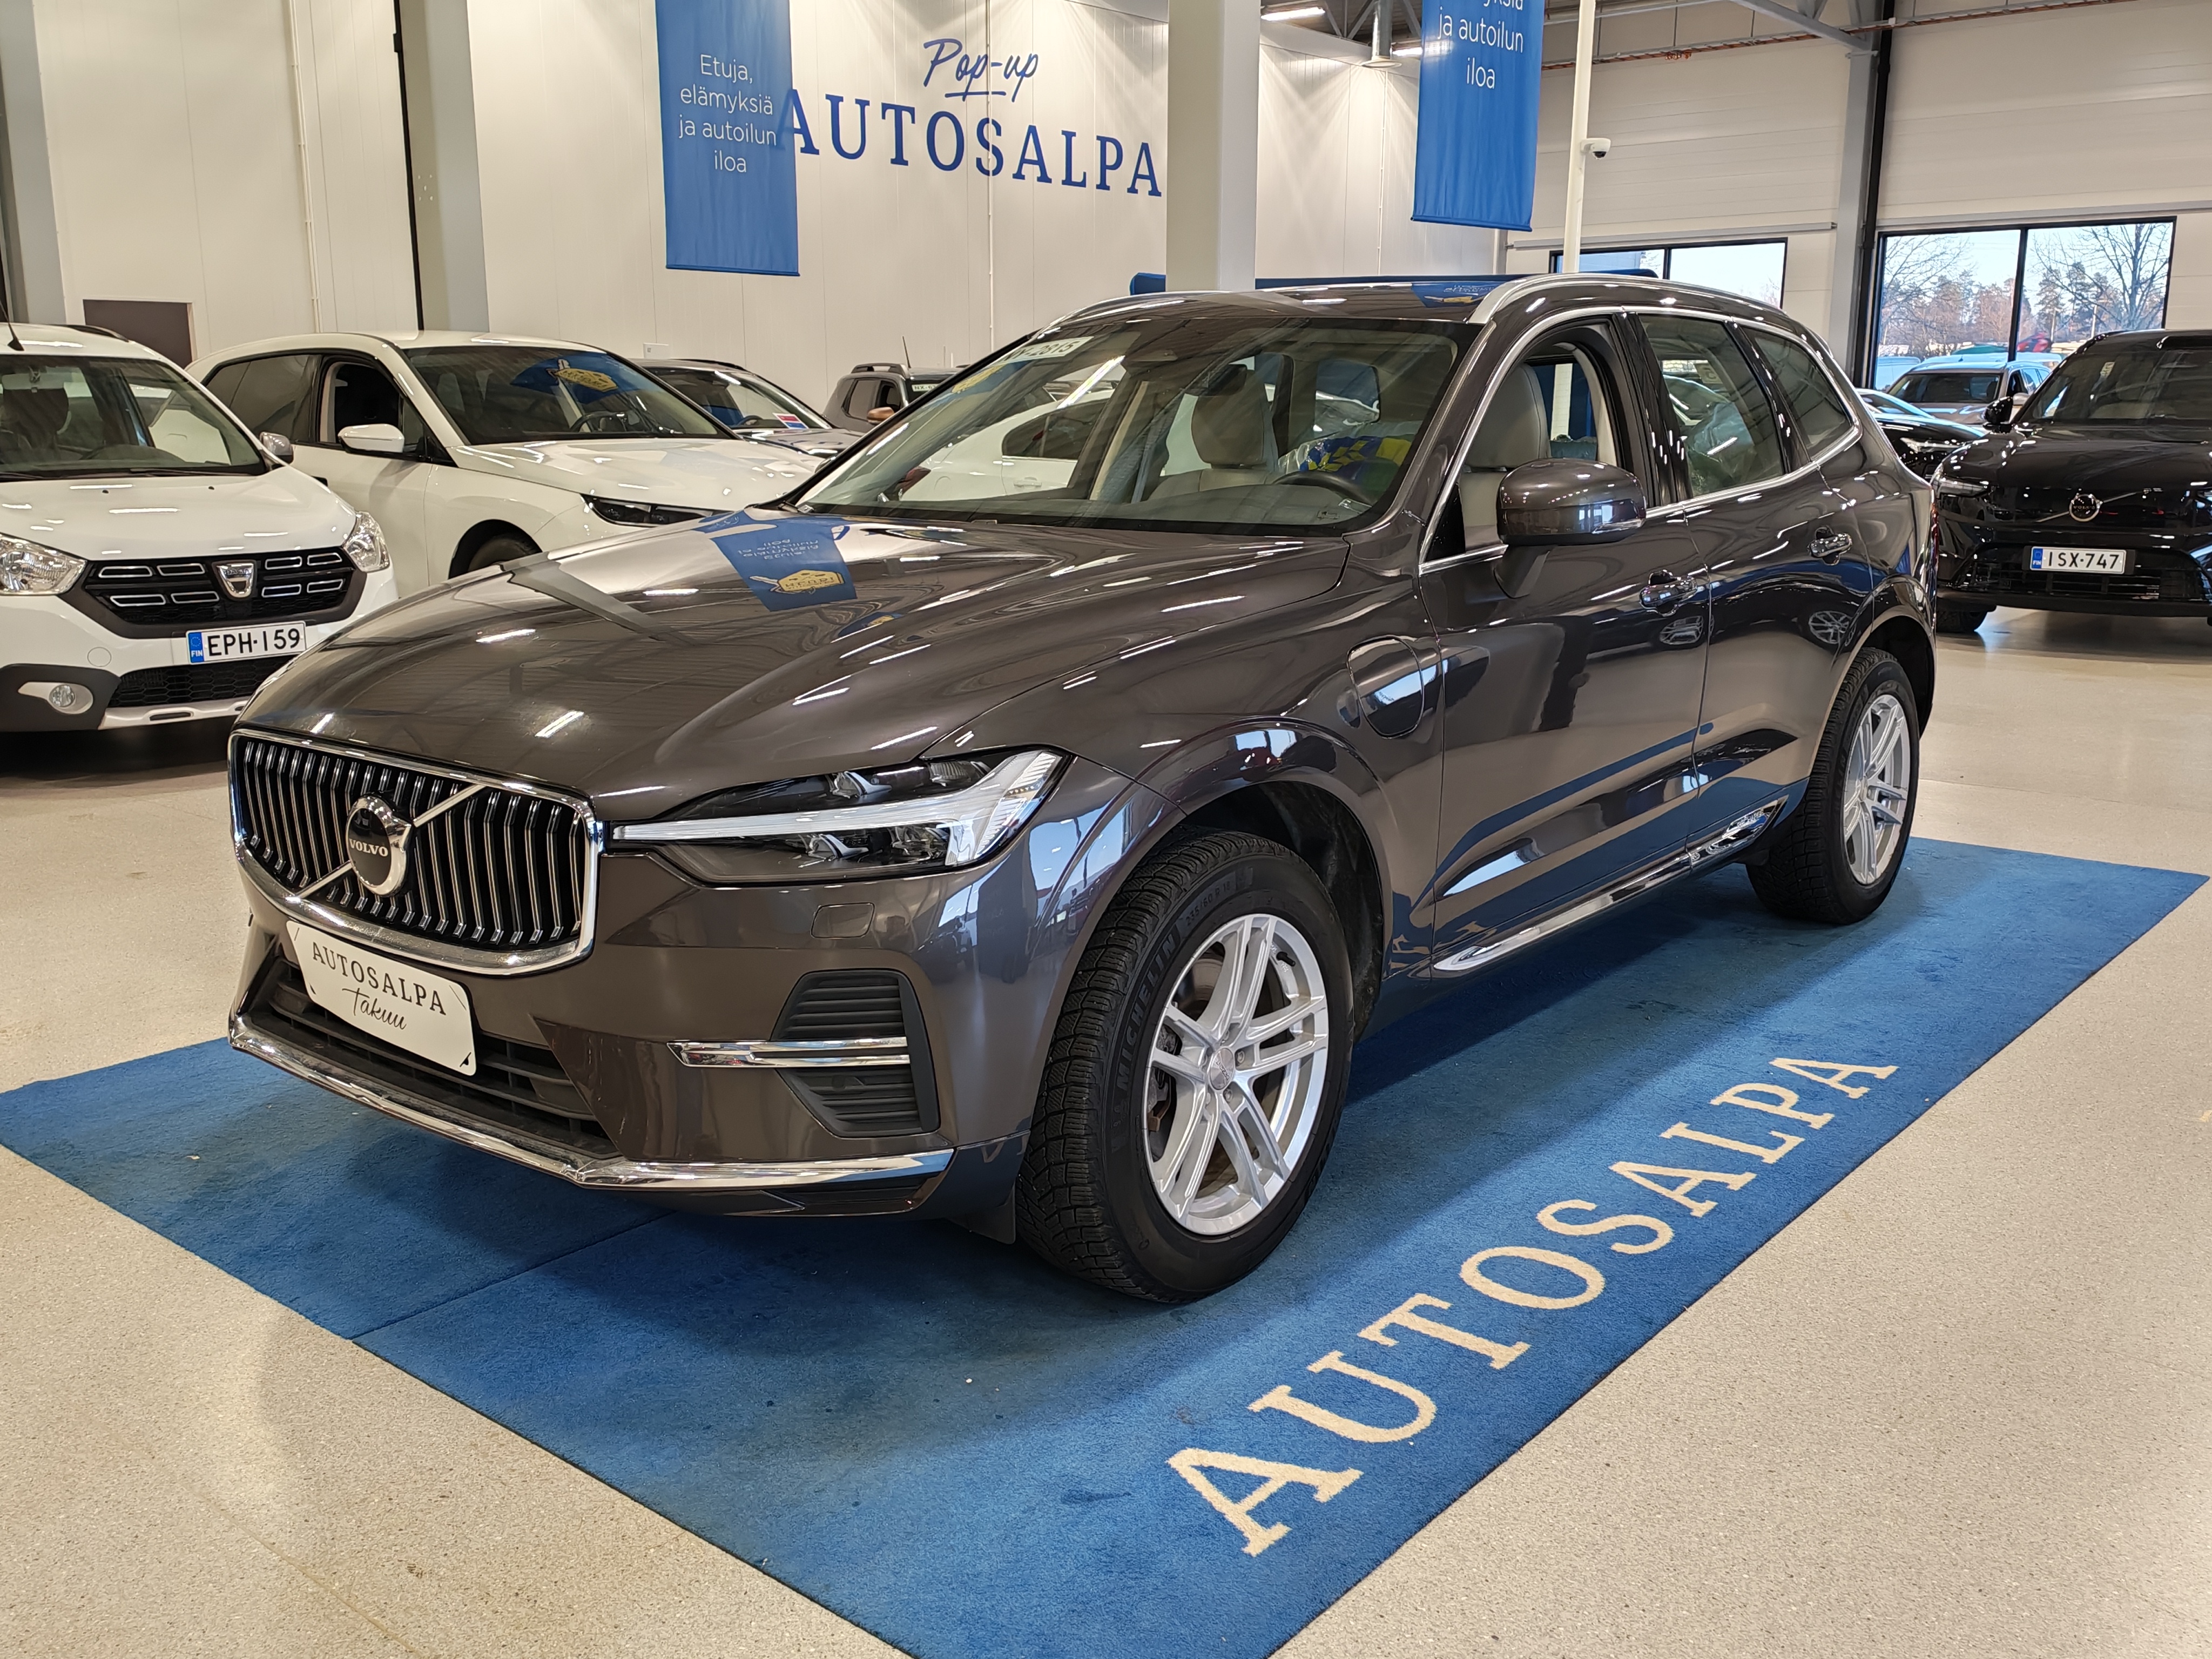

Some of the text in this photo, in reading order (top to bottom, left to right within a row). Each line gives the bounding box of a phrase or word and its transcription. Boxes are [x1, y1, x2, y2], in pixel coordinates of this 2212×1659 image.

[1437, 6, 1523, 53] ja autoilun
[700, 54, 753, 84] Etuja,
[923, 38, 1039, 103] Pop-up
[1467, 57, 1495, 89] iloa
[680, 84, 773, 115] elämyksiä
[678, 114, 777, 146] ja autoilun
[769, 88, 1162, 198] AUTOSALPA
[714, 150, 747, 173] iloa
[2048, 551, 2120, 569] ISX-747
[191, 649, 203, 658] FIN
[207, 628, 300, 657] EPH-159
[349, 838, 389, 857] VOLVO
[312, 941, 447, 1016] AUTOSALPA
[341, 987, 407, 1030] Takuu
[1166, 1057, 1900, 1556] AUTOSALPA
